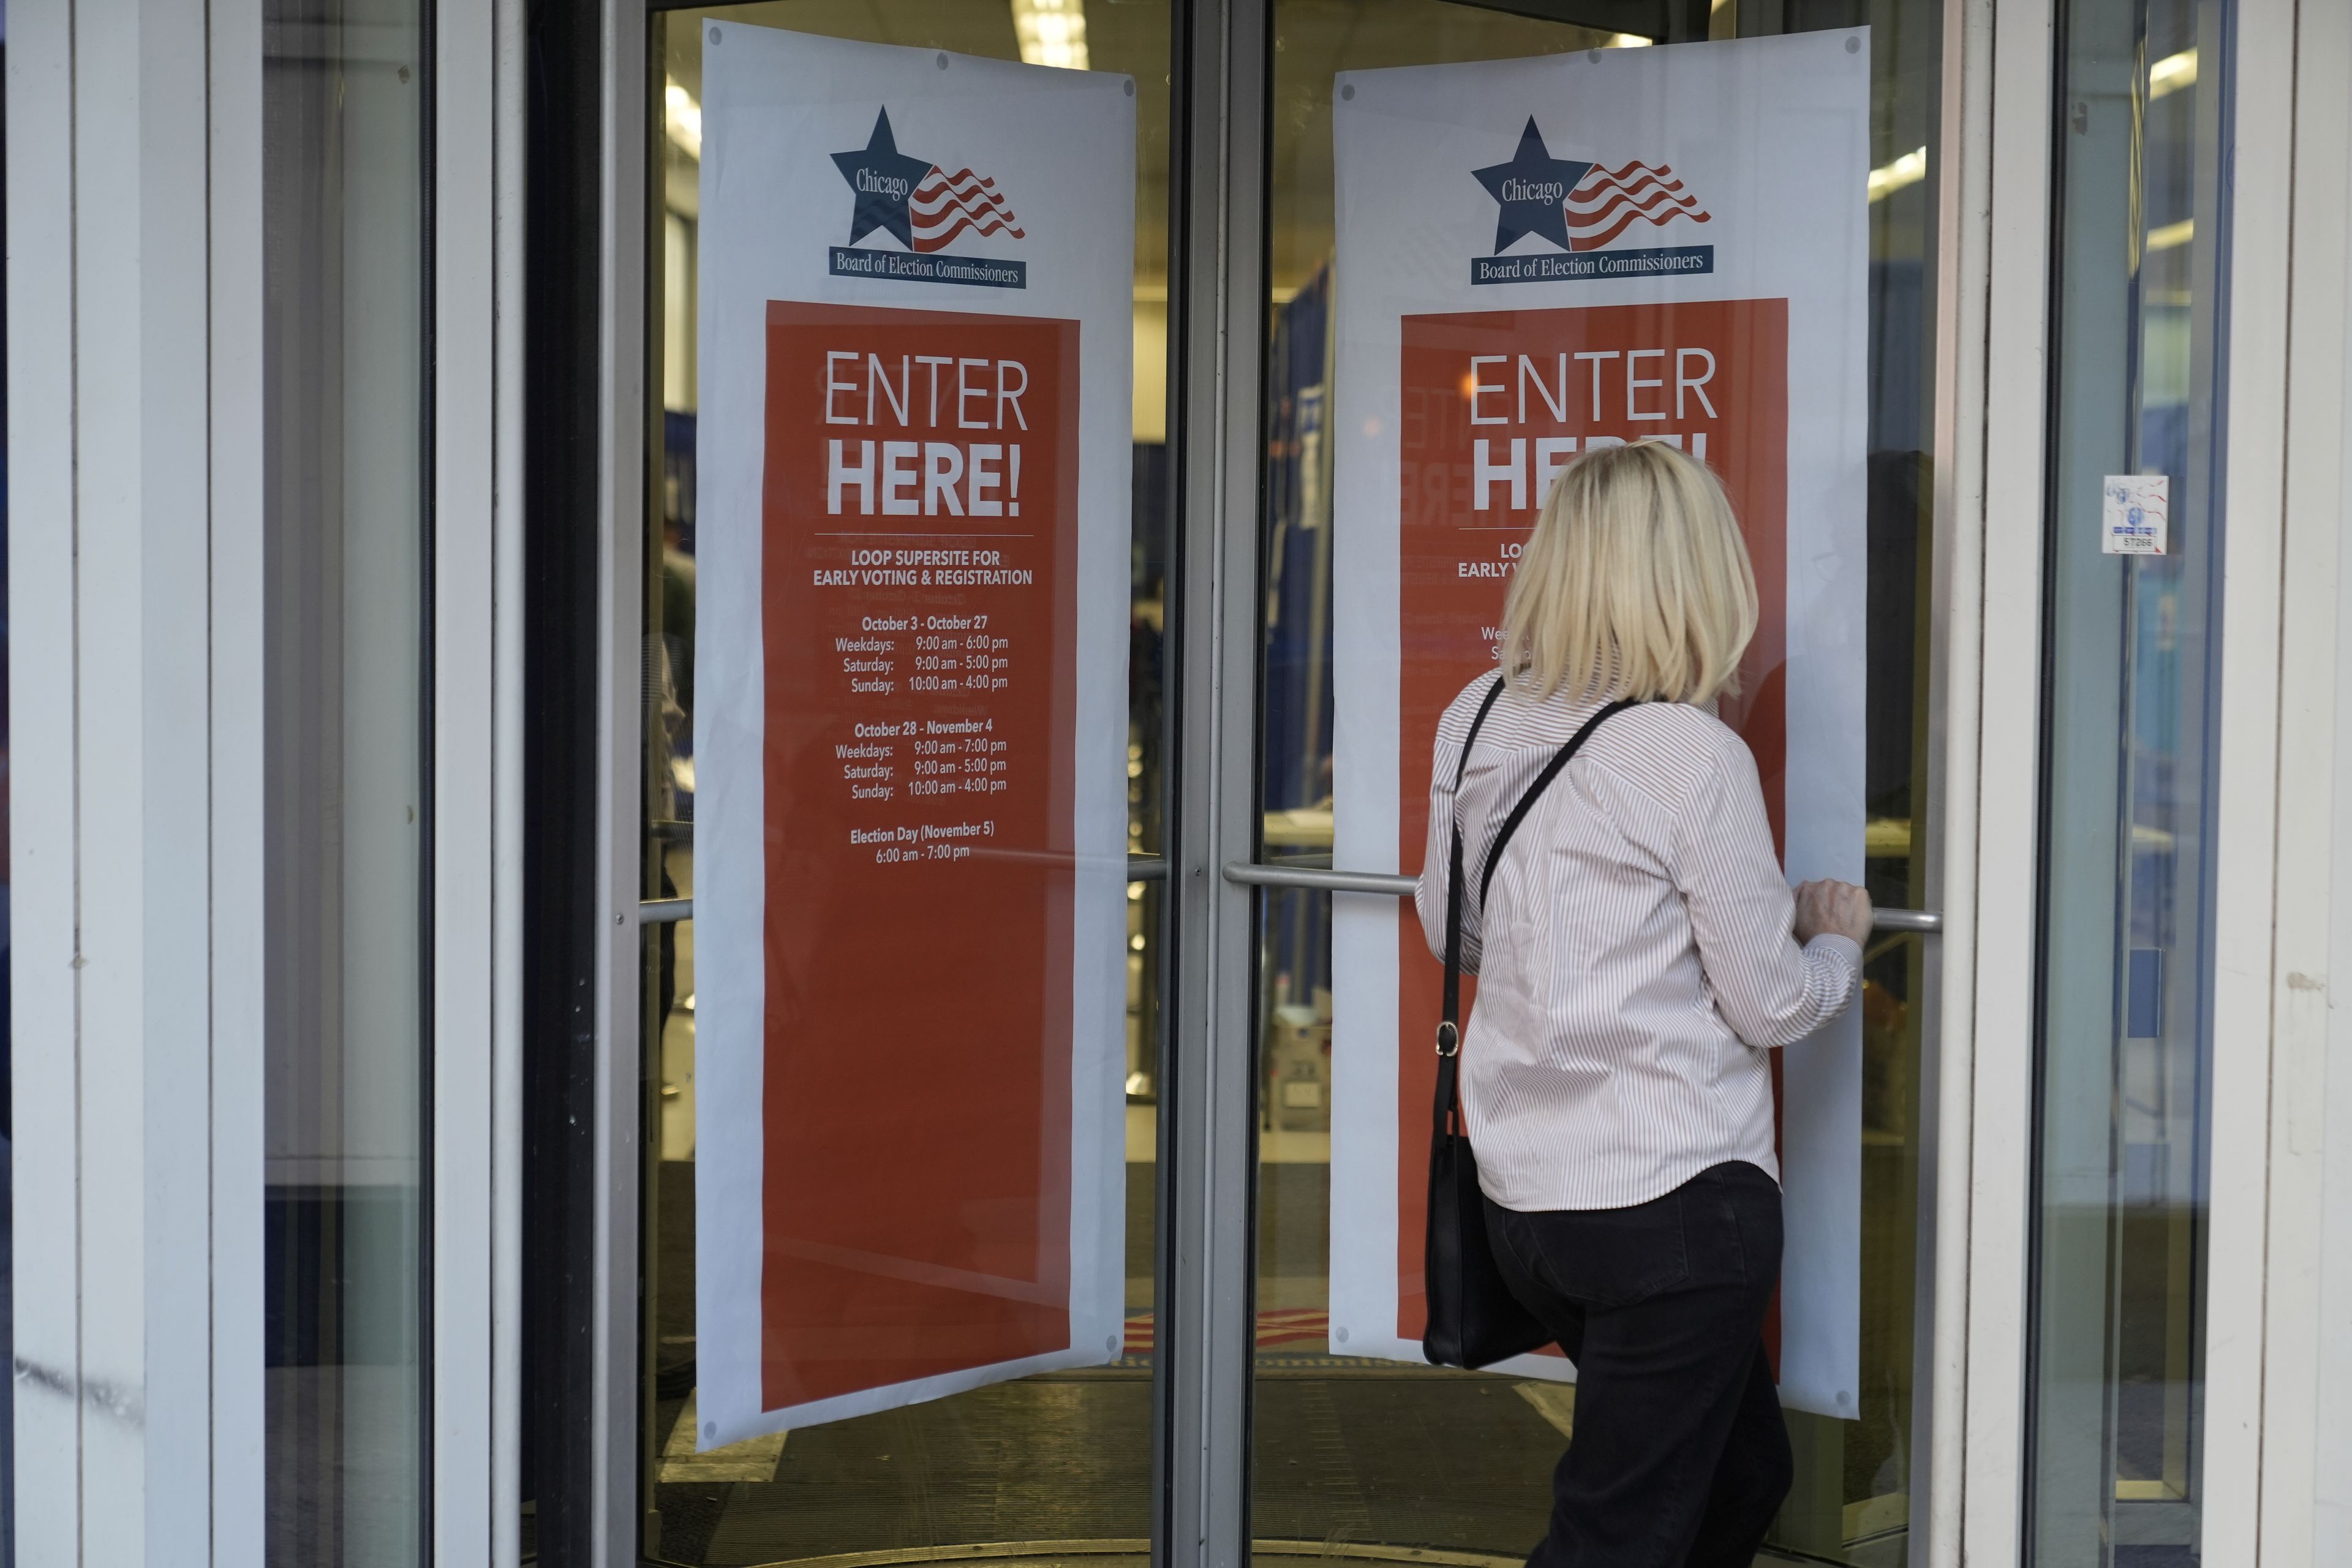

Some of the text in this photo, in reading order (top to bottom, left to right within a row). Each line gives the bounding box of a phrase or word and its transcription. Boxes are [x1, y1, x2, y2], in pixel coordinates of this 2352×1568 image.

[856, 167, 908, 202] Chicago
[1502, 177, 1563, 206] Chicago
[836, 252, 1019, 283] Board of Election Commissioners
[1480, 254, 1703, 279] Board of Election Commissioners
[826, 350, 1028, 431] ENTER
[1471, 347, 1718, 425] ENTER
[827, 439, 1020, 517] HERE!
[851, 549, 1000, 566] LOOP SUPERSITE FOR
[813, 569, 1032, 586] EARLY VOTING & REGISTRATION
[1458, 563, 1509, 577] EARLY
[862, 616, 908, 631] October
[910, 616, 918, 630] 3
[927, 614, 971, 630] October
[973, 615, 987, 629] 27
[835, 636, 894, 655] Weekdays:
[916, 636, 940, 650] 9:00
[941, 639, 957, 650] am
[966, 635, 989, 649] 6:00
[992, 638, 1008, 653] pm
[843, 657, 894, 675] Saturday:
[915, 655, 939, 670] 9:00
[941, 659, 957, 670] am
[966, 654, 989, 669] 5:00
[992, 658, 1008, 673] pm
[851, 677, 894, 695] Sunday:
[909, 676, 939, 691] 10:00
[941, 679, 957, 690] am
[965, 674, 989, 689] 4:00
[992, 677, 1008, 692] pm
[854, 722, 900, 738] October
[902, 721, 917, 736] 28
[927, 719, 984, 734] November
[985, 718, 993, 732] 4
[835, 742, 893, 761] Weekdays:
[914, 740, 938, 755] 9:00
[940, 743, 956, 754] am
[965, 738, 988, 753] 7:00
[990, 741, 1006, 756] pm
[844, 763, 894, 781] Saturday:
[914, 760, 938, 775] 9:00
[940, 763, 956, 774] am
[964, 758, 987, 773] 5:00
[990, 761, 1006, 775] pm
[851, 783, 894, 801] Sunday:
[908, 780, 938, 796] 10:00
[940, 783, 956, 794] am
[964, 777, 987, 792] 4:00
[990, 780, 1006, 795] pm
[851, 820, 994, 844] Election Day (November 5)
[876, 848, 900, 864] 6:00
[902, 850, 918, 861] am
[927, 845, 951, 859] 7:00
[953, 846, 970, 862] pm
